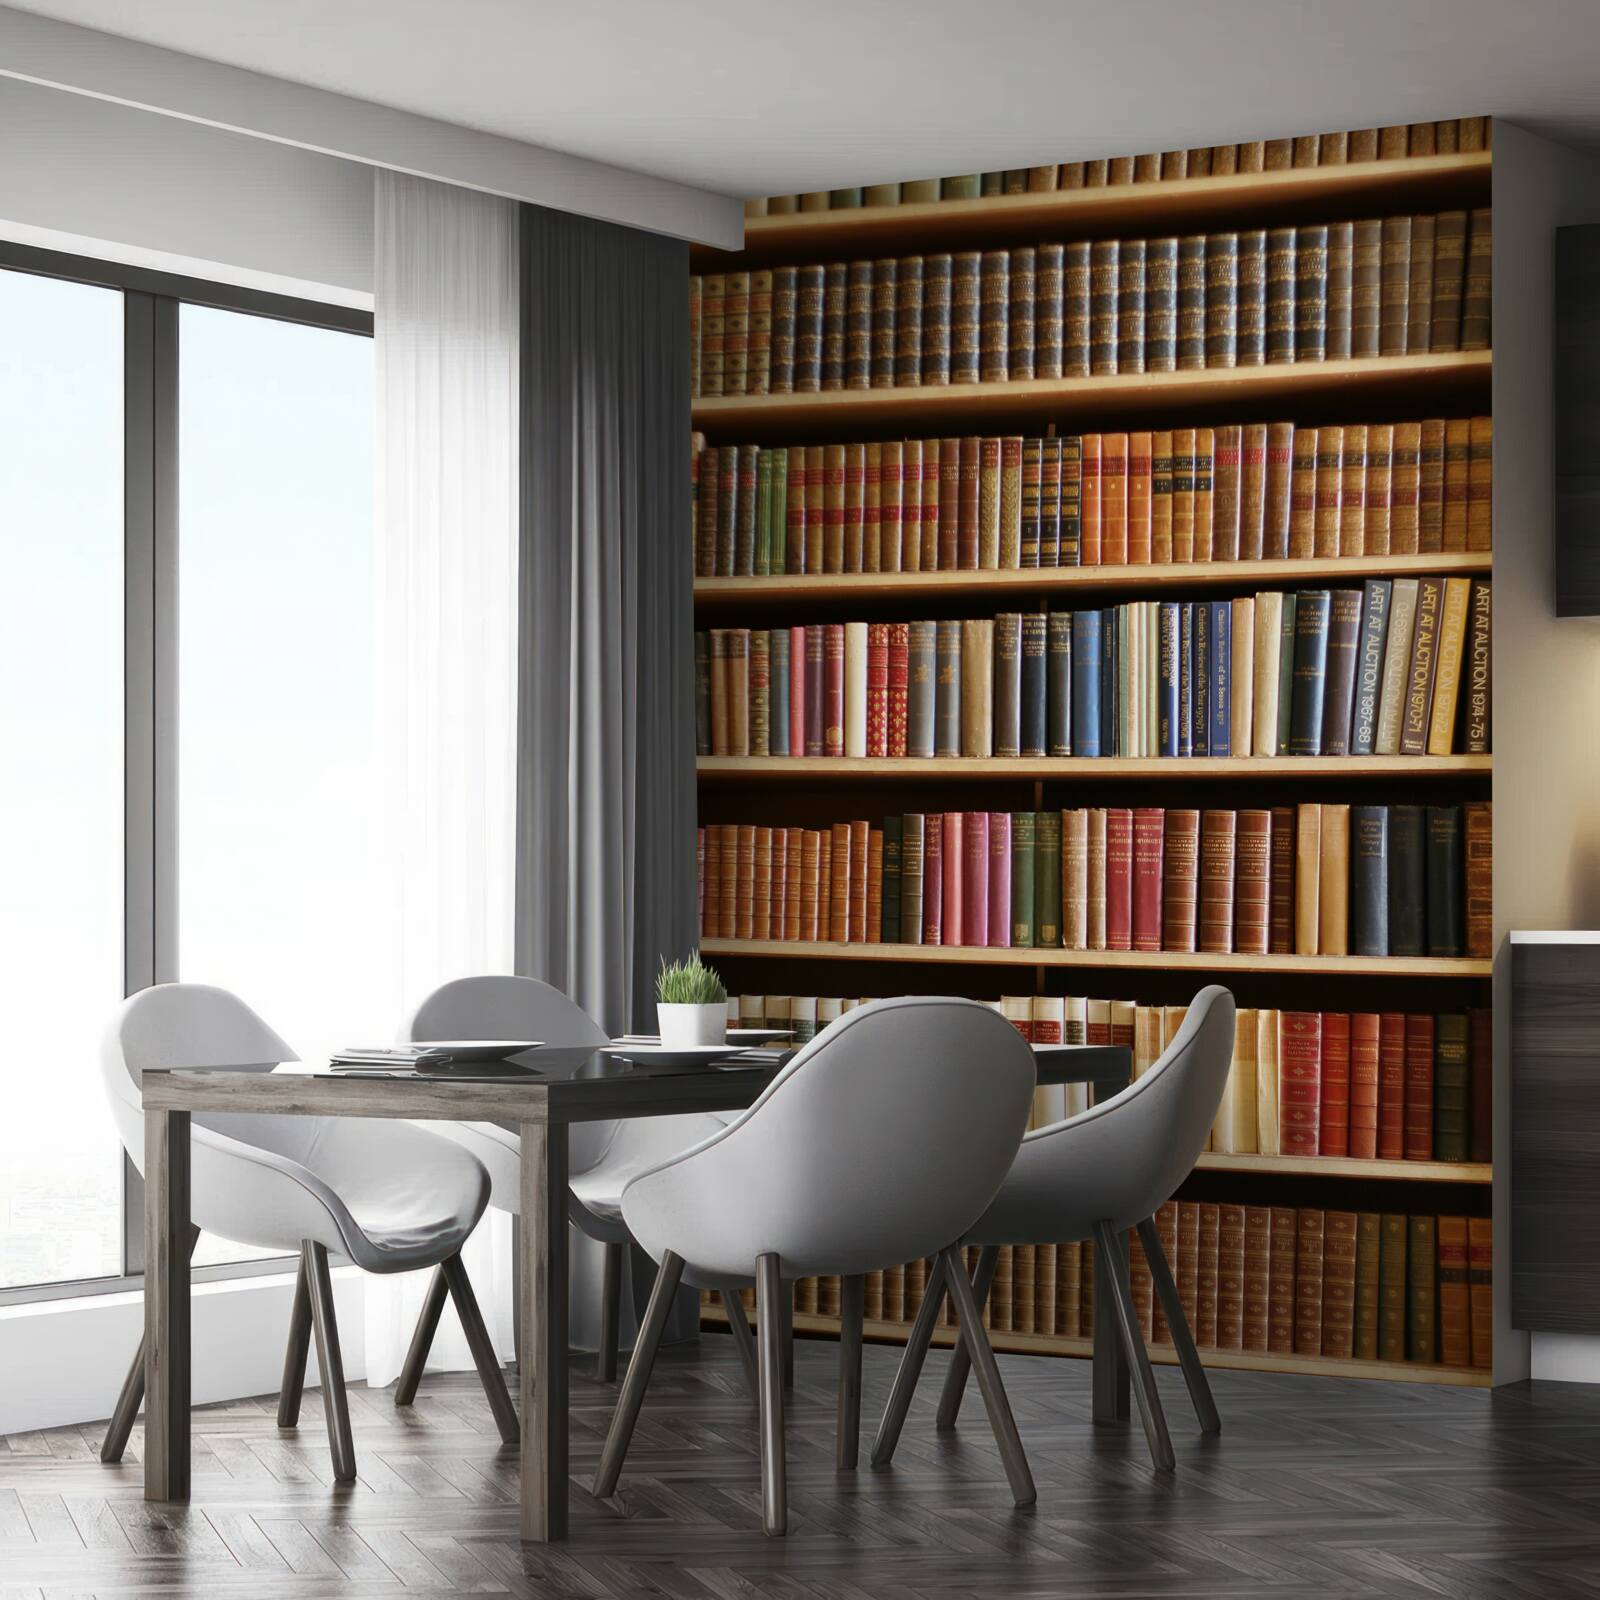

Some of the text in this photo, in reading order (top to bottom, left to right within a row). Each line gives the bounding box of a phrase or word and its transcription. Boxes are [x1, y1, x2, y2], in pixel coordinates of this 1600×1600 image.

[1420, 583, 1437, 613] ART
[1450, 584, 1464, 614] ART
[1475, 585, 1490, 614] ART
[1198, 608, 1206, 641] Christie's
[1420, 613, 1434, 630] AT
[1446, 613, 1460, 630] AT
[1475, 614, 1489, 631] AT
[1182, 640, 1190, 665] Review
[1198, 642, 1206, 667] Review
[1358, 584, 1385, 744] ART AT AUCTION 1967-68
[1412, 631, 1432, 692] AUCTION
[1440, 630, 1459, 690] AUCTION
[1472, 632, 1488, 690] AUCTION
[1198, 675, 1206, 688] the
[1381, 602, 1409, 749] ART AT AUCTION 1969-70
[1182, 688, 1190, 703] Year
[1197, 689, 1206, 706] Year
[1408, 692, 1425, 734] 1970-71
[1470, 693, 1486, 739] 1974-75
